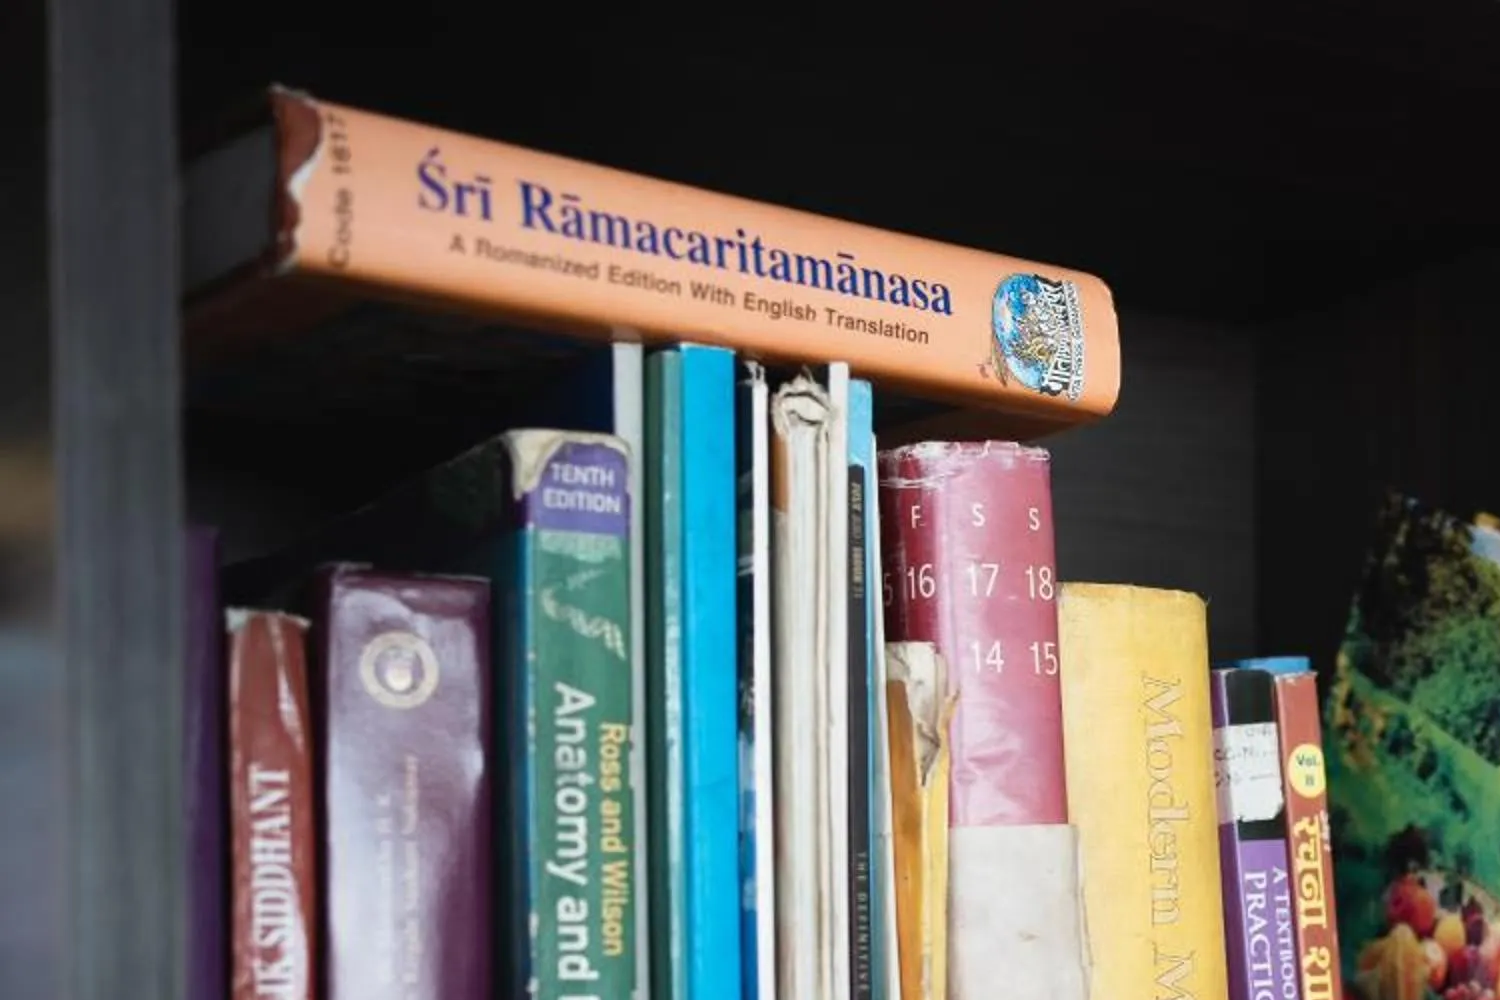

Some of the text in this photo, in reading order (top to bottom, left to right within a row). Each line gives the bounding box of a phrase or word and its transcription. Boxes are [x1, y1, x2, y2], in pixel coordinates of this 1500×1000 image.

[327, 189, 354, 267] Code
[416, 147, 954, 316] Śrī Rāmacaritamānasa
[448, 234, 930, 344] A Romanized Edition With English Translation
[542, 488, 621, 514] EDITION
[551, 463, 615, 486] TENTH
[911, 503, 1041, 531] F S S
[907, 564, 936, 600] 16
[966, 564, 999, 598] 17
[1025, 565, 1053, 601] 18
[971, 641, 1059, 676] 14 15
[547, 681, 597, 885] Anatomy
[1141, 671, 1191, 928] Modern
[248, 763, 294, 946] SIDDHANT
[599, 722, 628, 957] Ross and Wilson
[1272, 866, 1287, 883] A
[1293, 813, 1327, 929] रचना
[555, 897, 599, 981] and
